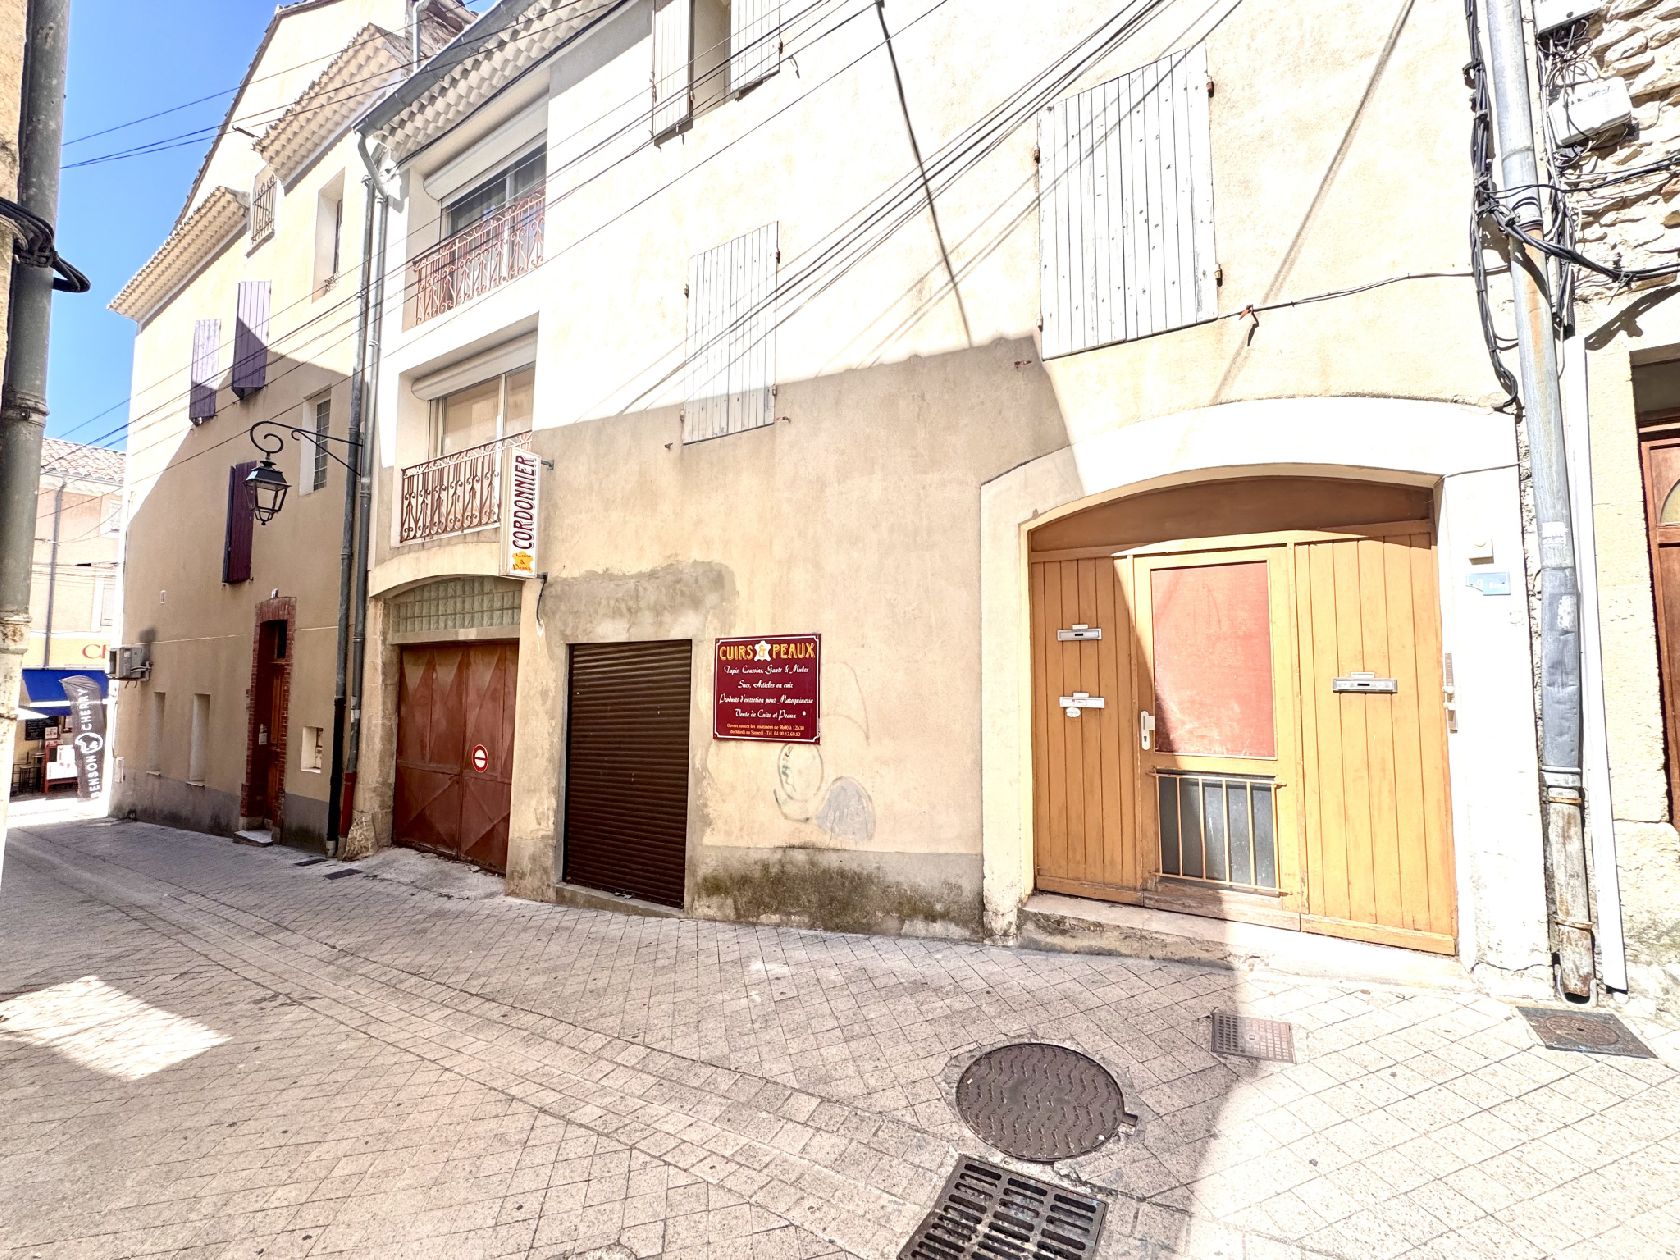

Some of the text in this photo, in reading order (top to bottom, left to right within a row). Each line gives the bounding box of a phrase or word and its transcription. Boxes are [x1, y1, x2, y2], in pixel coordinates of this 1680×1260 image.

[512, 455, 536, 550] CORDONNIER
[719, 645, 754, 661] CUIRS
[772, 643, 816, 659] PEAUX
[76, 689, 92, 732] CHERRY
